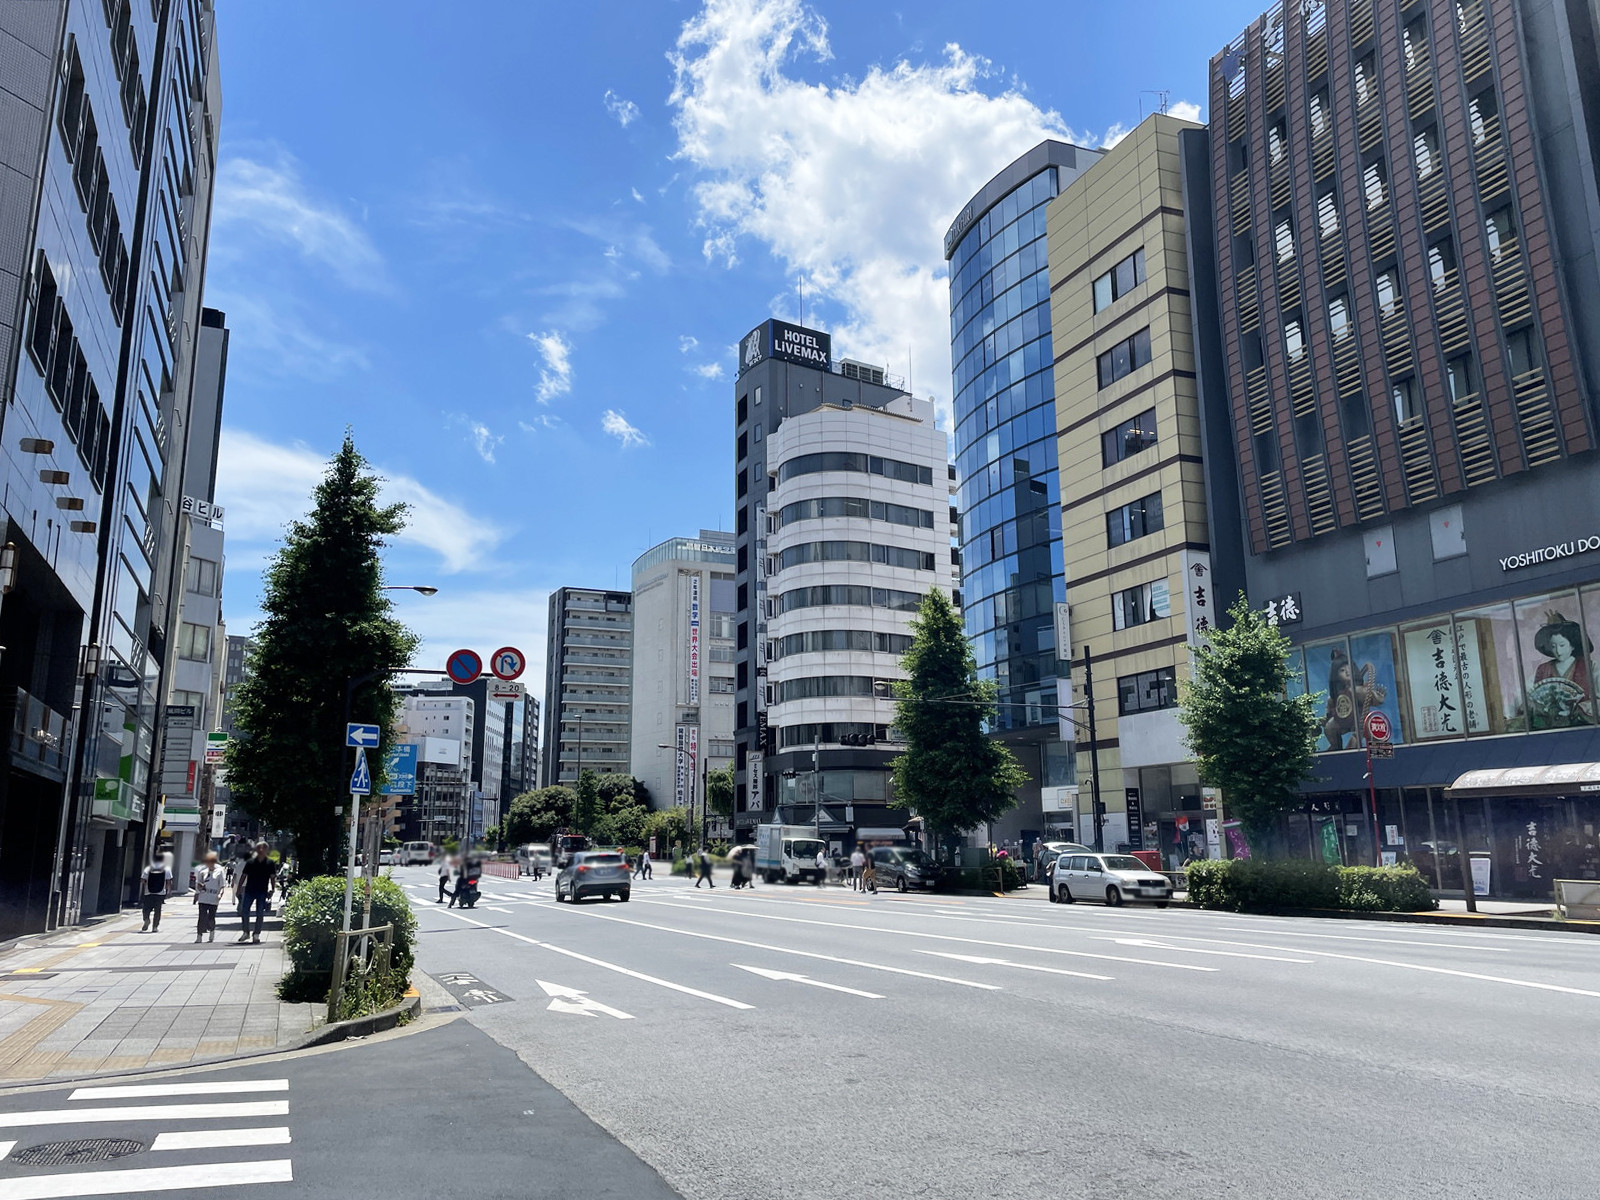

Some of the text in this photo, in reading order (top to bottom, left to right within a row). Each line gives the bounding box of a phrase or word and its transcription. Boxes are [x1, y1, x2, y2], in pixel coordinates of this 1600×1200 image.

[784, 329, 819, 349] HOTEL
[183, 497, 222, 518] 谷ビル
[1499, 542, 1575, 571] YOSHITOKU
[1267, 595, 1300, 625] 吉徳
[1431, 647, 1457, 732] 吉徳大光
[1456, 624, 1477, 729] 江戸で最古の人形の老舗
[1525, 821, 1543, 878] 吉徳大光
